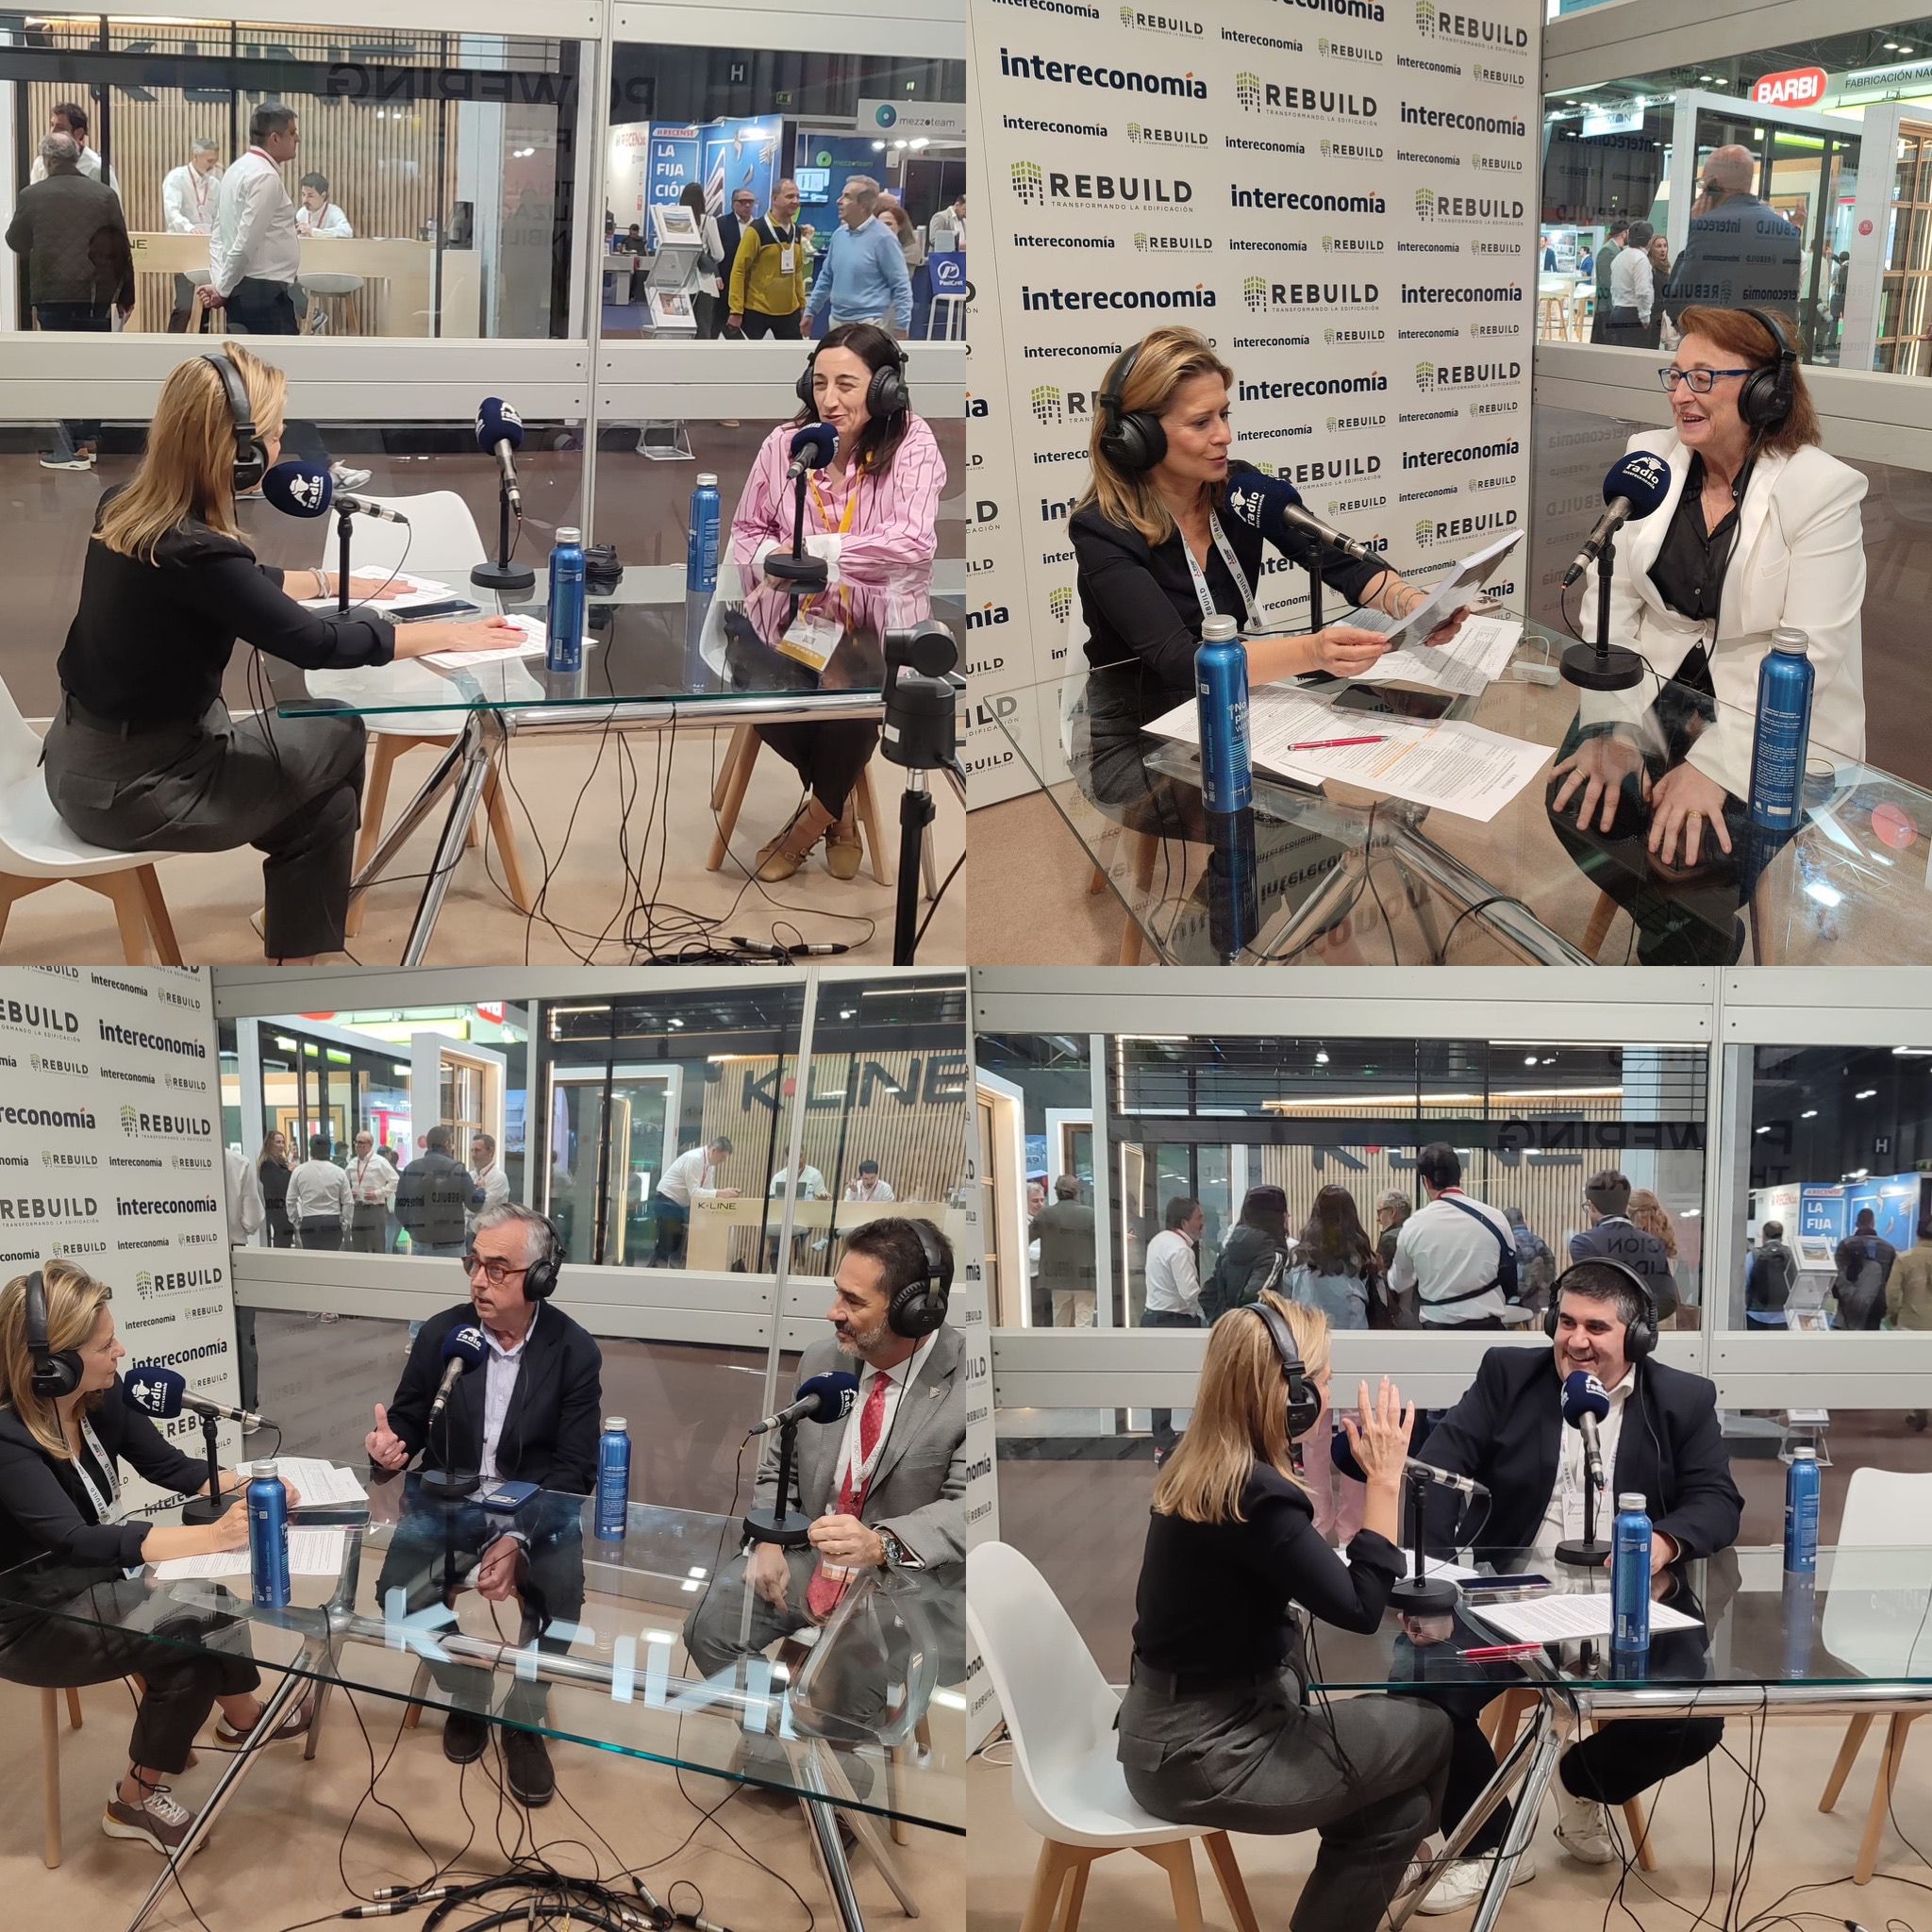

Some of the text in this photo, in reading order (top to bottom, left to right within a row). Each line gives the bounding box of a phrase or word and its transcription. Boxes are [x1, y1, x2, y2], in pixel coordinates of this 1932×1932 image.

[1136, 12, 1204, 35] REBUILD
[1439, 12, 1528, 47] REBUILD
[1221, 26, 1303, 52] intereconomía
[1331, 43, 1383, 62] REBUILD
[730, 64, 744, 80] H
[1000, 47, 1208, 100] intereconomía
[1397, 55, 1461, 75] intereconomía
[1483, 69, 1524, 85] REBUILD
[1845, 69, 1912, 89] FABRICACIÓN
[1757, 75, 1819, 104] BARBI
[1265, 83, 1377, 117] REBUILD
[1003, 114, 1108, 138] intereconomía
[1401, 101, 1525, 138] intereconomía
[1143, 127, 1208, 145] REBUILD
[658, 144, 675, 158] LA
[1225, 136, 1306, 155] intereconomía
[1332, 143, 1384, 158] REBUILD
[1397, 150, 1460, 166] intereconomía
[1482, 158, 1523, 172] REBUILD
[657, 163, 684, 176] FIJA
[1049, 173, 1192, 203] REBUILD
[1051, 201, 1126, 210] TRANSFORMANDO
[1231, 184, 1386, 214] intereconomía
[1438, 196, 1524, 219] REBUILD
[1014, 233, 1115, 249] intereconomía
[1150, 237, 1212, 250] REBUILD
[1229, 239, 1307, 253] intereconomía
[1334, 239, 1384, 251] REBUILD
[1397, 242, 1459, 254] intereconomía
[1480, 242, 1521, 254] REBUILD
[1022, 283, 1217, 311] intereconomía
[1272, 284, 1379, 304] REBUILD
[1401, 281, 1523, 305] intereconomía
[1336, 330, 1385, 341] REBUILD
[1398, 327, 1459, 340] intereconomía
[1479, 325, 1520, 335] REBUILD
[1024, 341, 1123, 358] intereconomía
[1233, 334, 1310, 348] intereconomía
[1438, 362, 1521, 384] REBUILD
[1239, 370, 1388, 402] intereconomía
[1399, 408, 1458, 423] intereconomía
[1478, 402, 1518, 414] REBUILD
[1338, 415, 1386, 428] REBUILD
[1238, 424, 1312, 441] intereconomía
[1403, 437, 1520, 469] intereconomía
[1278, 456, 1381, 484] REBUILD
[1626, 463, 1659, 485] radio
[1477, 475, 1517, 490] REBUILD
[307, 475, 320, 508] radio
[1399, 484, 1458, 503] intereconomía
[1247, 491, 1260, 526] radio
[1340, 496, 1387, 511] REBUILD
[1437, 509, 1518, 539] REBUILD
[91, 973, 148, 997] intereconomía
[166, 991, 201, 1009] REBUILD
[99, 1019, 206, 1058] intereconomía
[42, 1058, 89, 1074] REBUILD
[100, 1067, 156, 1084] intereconomía
[173, 1077, 207, 1091] REBUILD
[140, 1113, 211, 1135] REBUILD
[1874, 1139, 1888, 1153] H
[53, 1154, 97, 1165] REBUILD
[109, 1156, 162, 1168] intereconomía
[179, 1158, 211, 1168] REBUILD
[0, 1197, 97, 1219] REBUILD
[116, 1194, 217, 1216] intereconomía
[1807, 1203, 1824, 1213] LA
[1807, 1218, 1832, 1230] FIJA
[117, 1238, 169, 1250] intereconomía
[186, 1233, 218, 1243] REBUILD
[63, 1241, 107, 1254] REBUILD
[154, 1268, 222, 1291] REBUILD
[192, 1305, 223, 1317] REBUILD
[125, 1313, 175, 1330] intereconomía
[197, 1373, 227, 1388] REBUILD
[151, 1381, 162, 1411] radio
